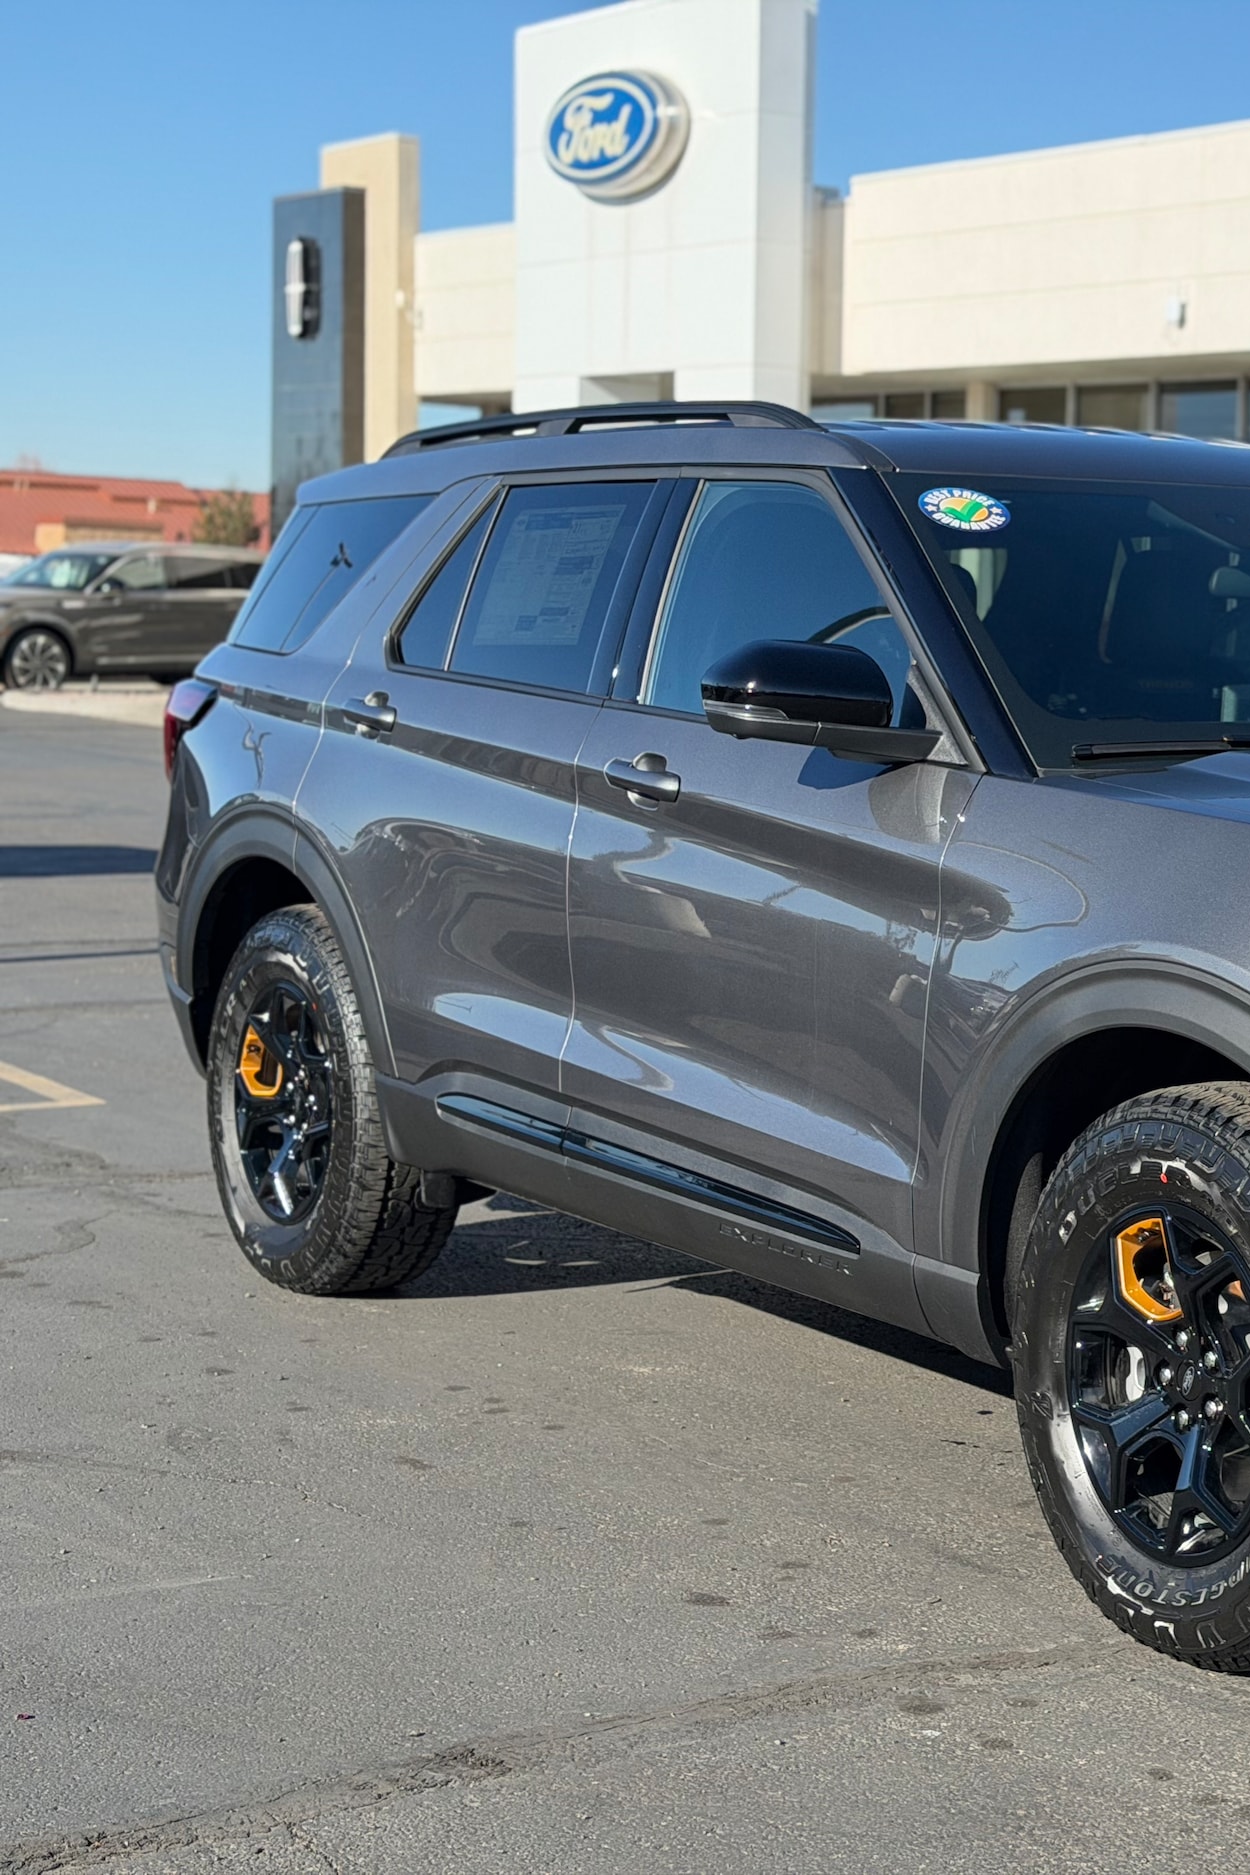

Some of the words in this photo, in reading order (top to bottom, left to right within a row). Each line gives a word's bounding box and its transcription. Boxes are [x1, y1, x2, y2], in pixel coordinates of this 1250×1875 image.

[556, 91, 633, 165] Ford
[923, 489, 952, 505] BEST
[952, 489, 996, 507] PRICE
[931, 511, 1007, 531] GUARANTEE
[719, 1222, 854, 1277] EXPLORER
